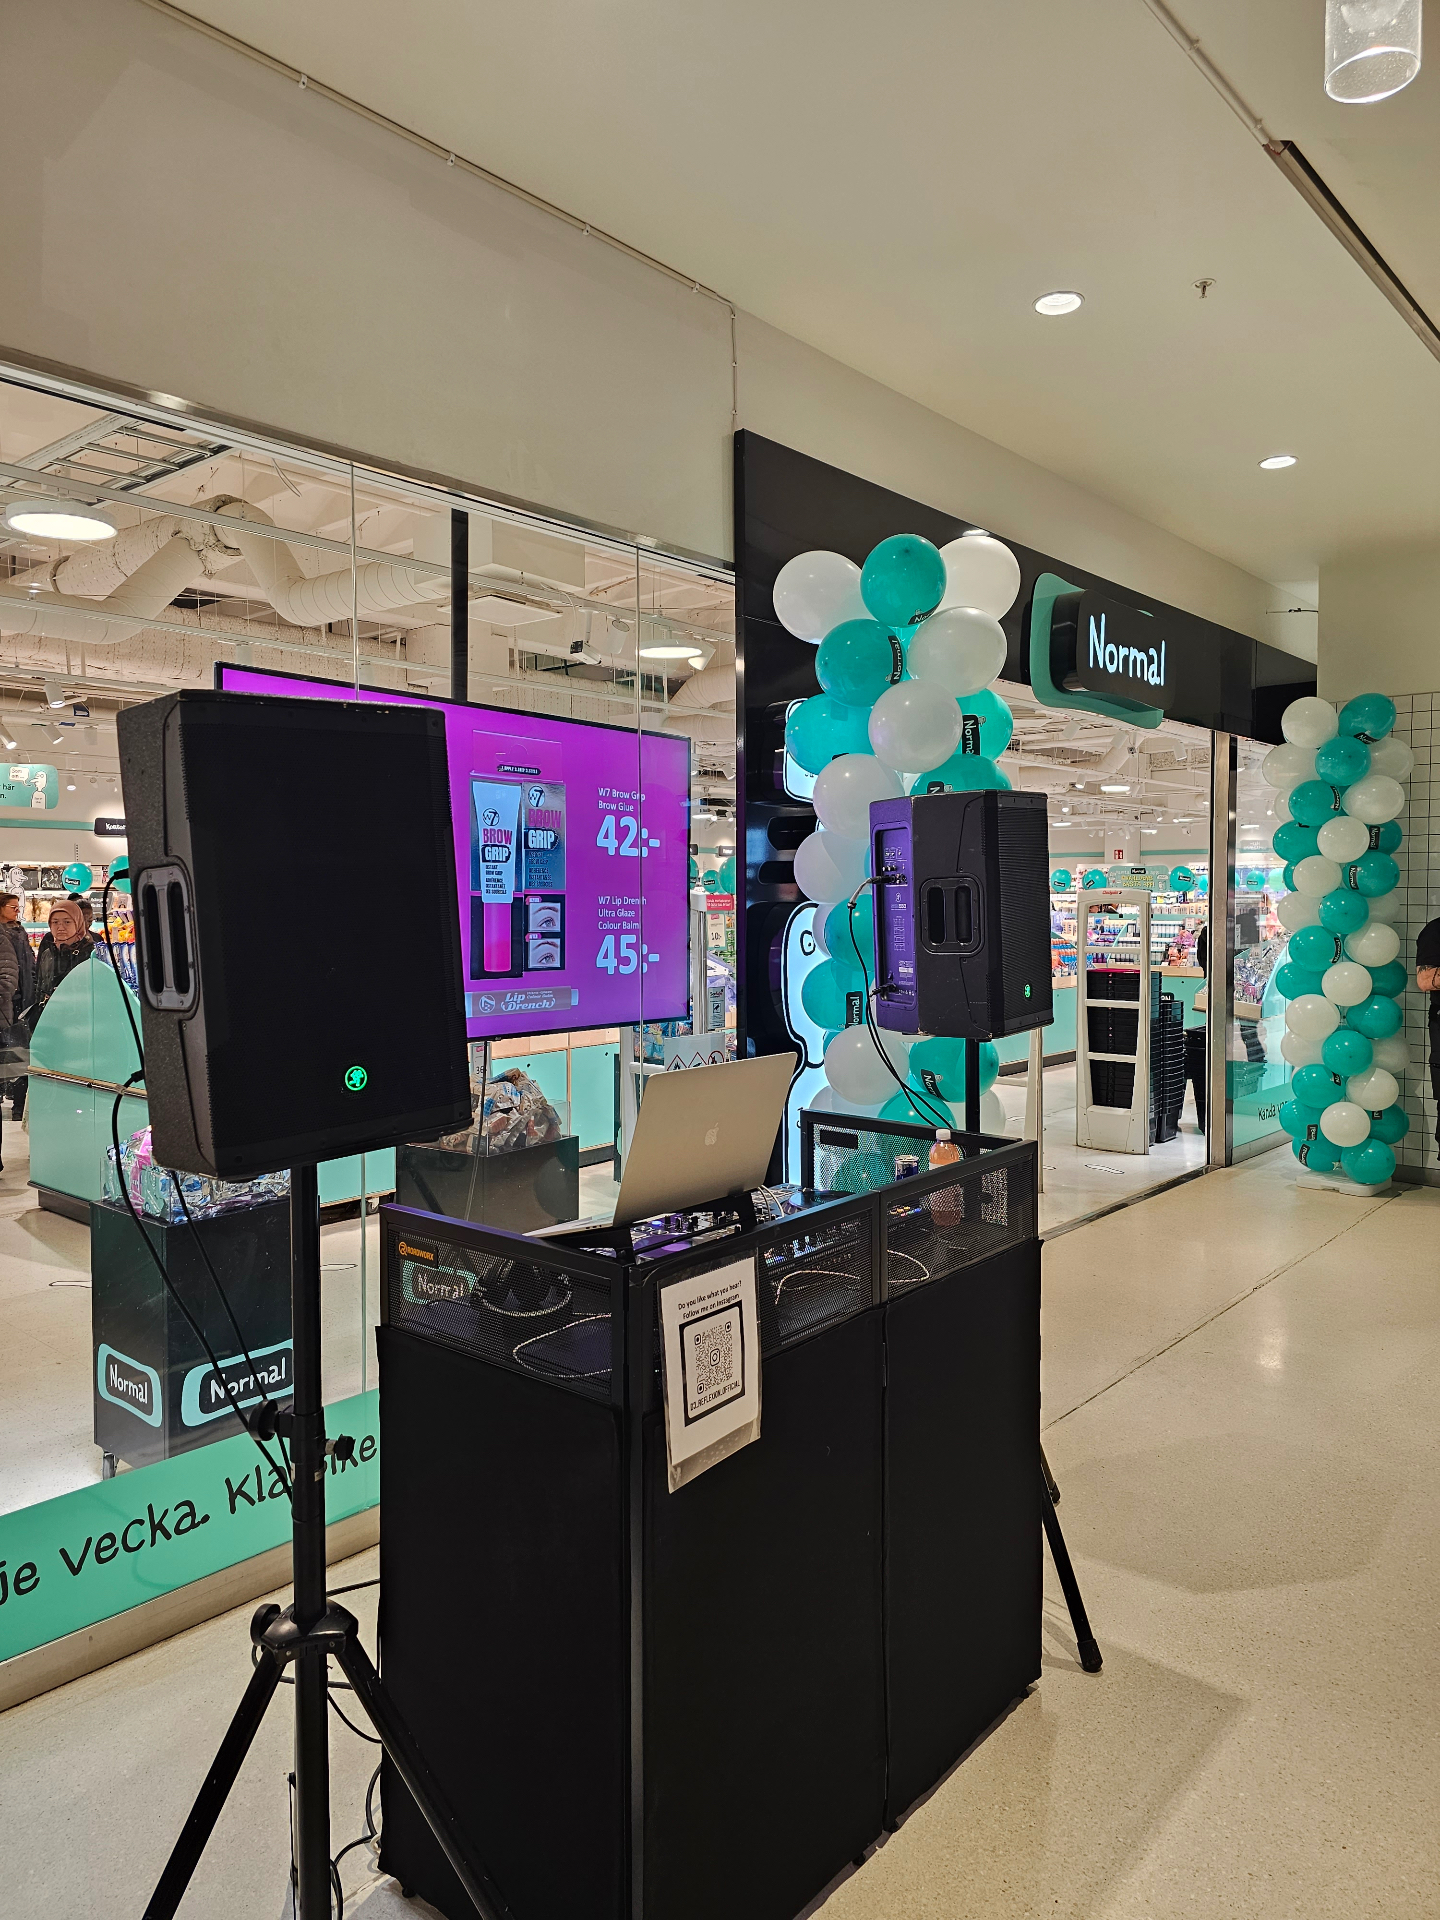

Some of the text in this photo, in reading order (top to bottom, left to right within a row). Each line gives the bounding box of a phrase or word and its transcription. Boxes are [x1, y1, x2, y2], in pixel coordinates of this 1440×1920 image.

[1089, 612, 1166, 687] Normal
[892, 639, 902, 681] Normal
[598, 787, 646, 803] W7 Brow Grp
[598, 800, 634, 812] Brow Glue
[528, 808, 562, 828] BROW
[483, 828, 512, 845] BROW
[528, 829, 555, 849] GRIP
[597, 814, 660, 858] 42:-
[485, 846, 509, 862] GRIP
[598, 896, 647, 906] W7 Lip Drenh
[598, 908, 636, 917] Ultra Glaze
[598, 921, 640, 930] Colour Balm
[596, 934, 660, 975] 45:-
[502, 998, 556, 1011] Drench
[505, 992, 525, 1003] Lip
[407, 1246, 434, 1261] ROADWORX
[418, 1273, 464, 1299] Normal
[677, 1280, 742, 1311] Do you like what you hear?
[683, 1309, 700, 1320] Follow
[701, 1305, 709, 1313] me
[716, 1293, 740, 1307] Instagram
[109, 1363, 149, 1404] Normal
[210, 1356, 287, 1404] Normal
[59, 1499, 210, 1577] vecka.
